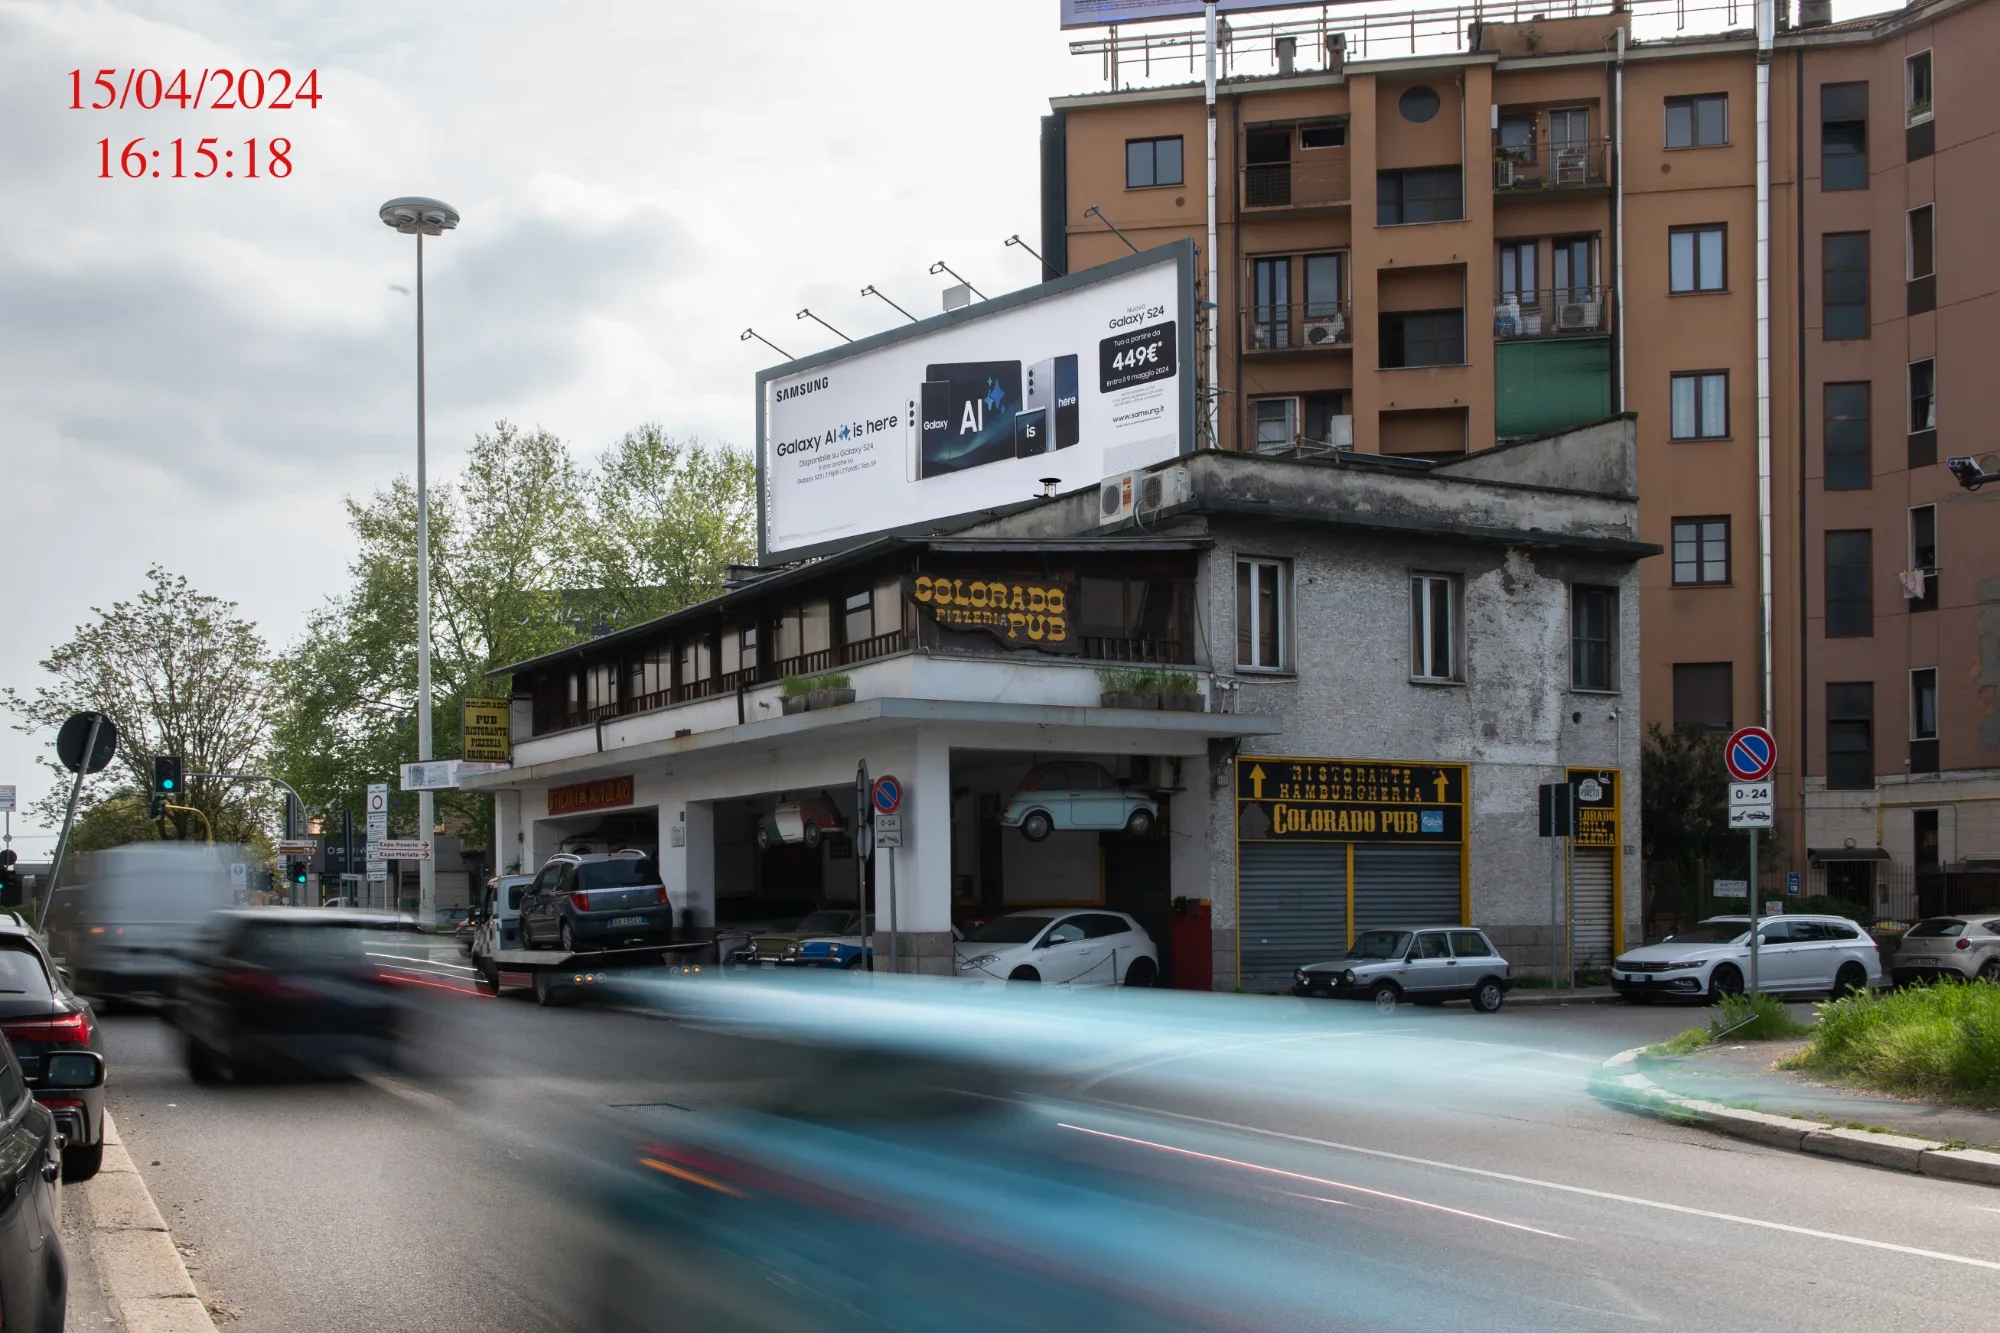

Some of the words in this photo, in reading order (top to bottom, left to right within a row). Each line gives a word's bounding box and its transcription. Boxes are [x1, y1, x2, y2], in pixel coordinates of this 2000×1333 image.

[1126, 304, 1146, 314] Nuovo
[1108, 312, 1144, 329] Galaxy
[1146, 305, 1164, 319] S24
[1114, 338, 1125, 347] Tuo
[1130, 332, 1151, 344] partire
[1106, 378, 1122, 387] Entro
[1131, 370, 1154, 380] maggio
[1155, 366, 1170, 375] 2024
[776, 376, 829, 402] SAMSUNG
[1058, 395, 1077, 409] here
[960, 398, 983, 436] AI
[1112, 405, 1165, 423] www.samsung.it
[924, 419, 948, 431] Galaxy
[1026, 424, 1036, 438] is
[777, 435, 822, 457] Galaxy
[825, 428, 836, 445] AI
[852, 422, 863, 438] is
[866, 415, 898, 434] here
[798, 452, 831, 468] Disponibile
[832, 451, 840, 459] su
[840, 446, 862, 458] Galaxy
[862, 442, 874, 452] S24
[832, 458, 848, 468] anche
[796, 476, 814, 485] Galaxy
[914, 576, 1066, 614] COLORADO
[935, 608, 1008, 626] PIZZERIA
[1007, 612, 1066, 642] PUB
[466, 701, 508, 710] COLORADO
[476, 714, 498, 725] PUB
[466, 726, 508, 737] RISTORANTE
[471, 738, 502, 748] PIZZERIA
[467, 750, 506, 760] GRIGLIERIA
[1279, 783, 1422, 802] HAMBURGHERIA
[1580, 788, 1600, 798] PORETTI
[1273, 804, 1376, 834] COLORADO
[1381, 811, 1419, 834] PUB
